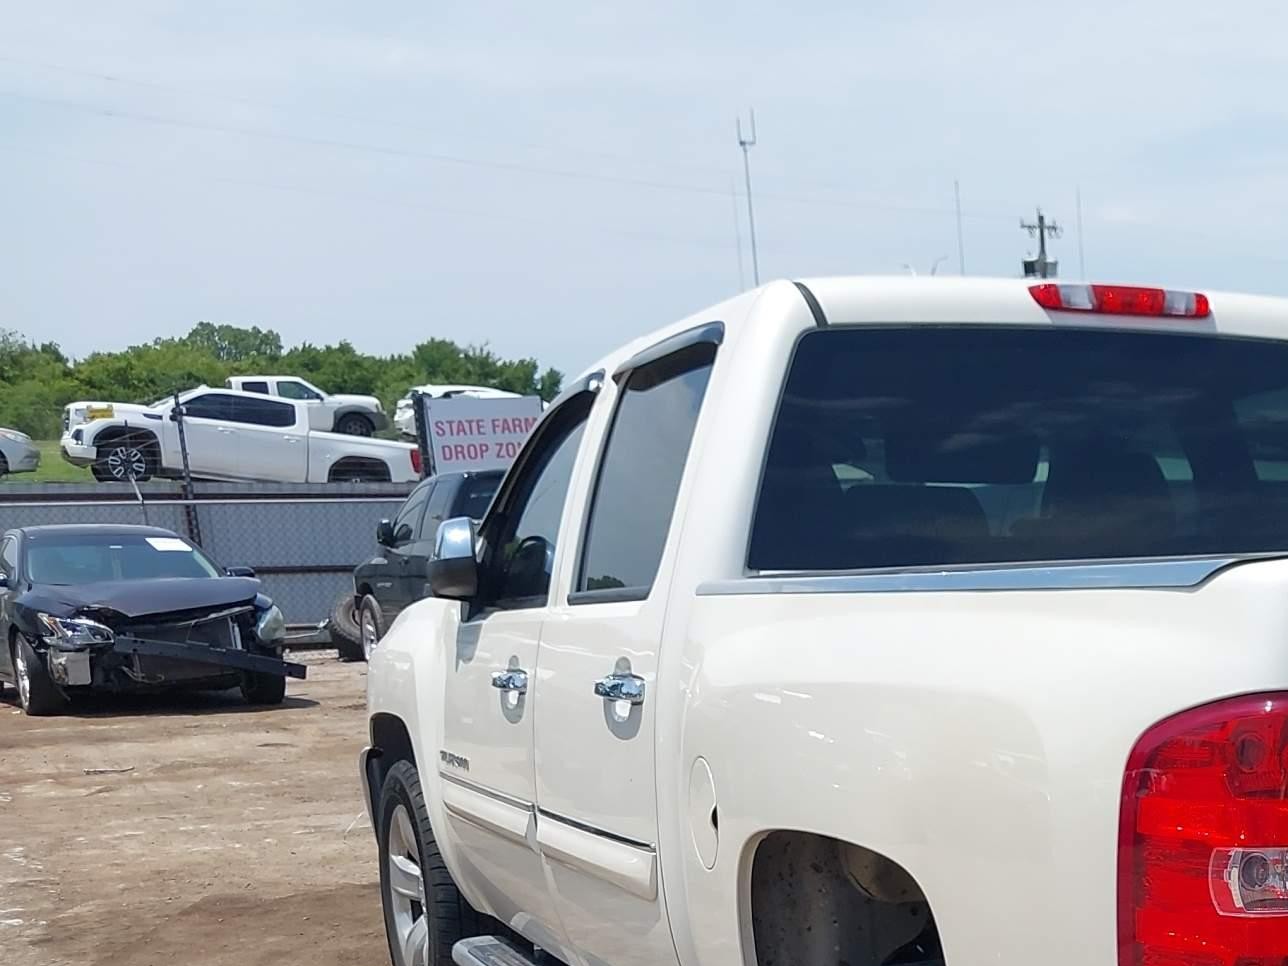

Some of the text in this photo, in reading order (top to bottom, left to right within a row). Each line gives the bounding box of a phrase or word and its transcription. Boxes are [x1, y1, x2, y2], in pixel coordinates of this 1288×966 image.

[434, 416, 538, 438] STATE FARM
[441, 443, 489, 461] DROP
